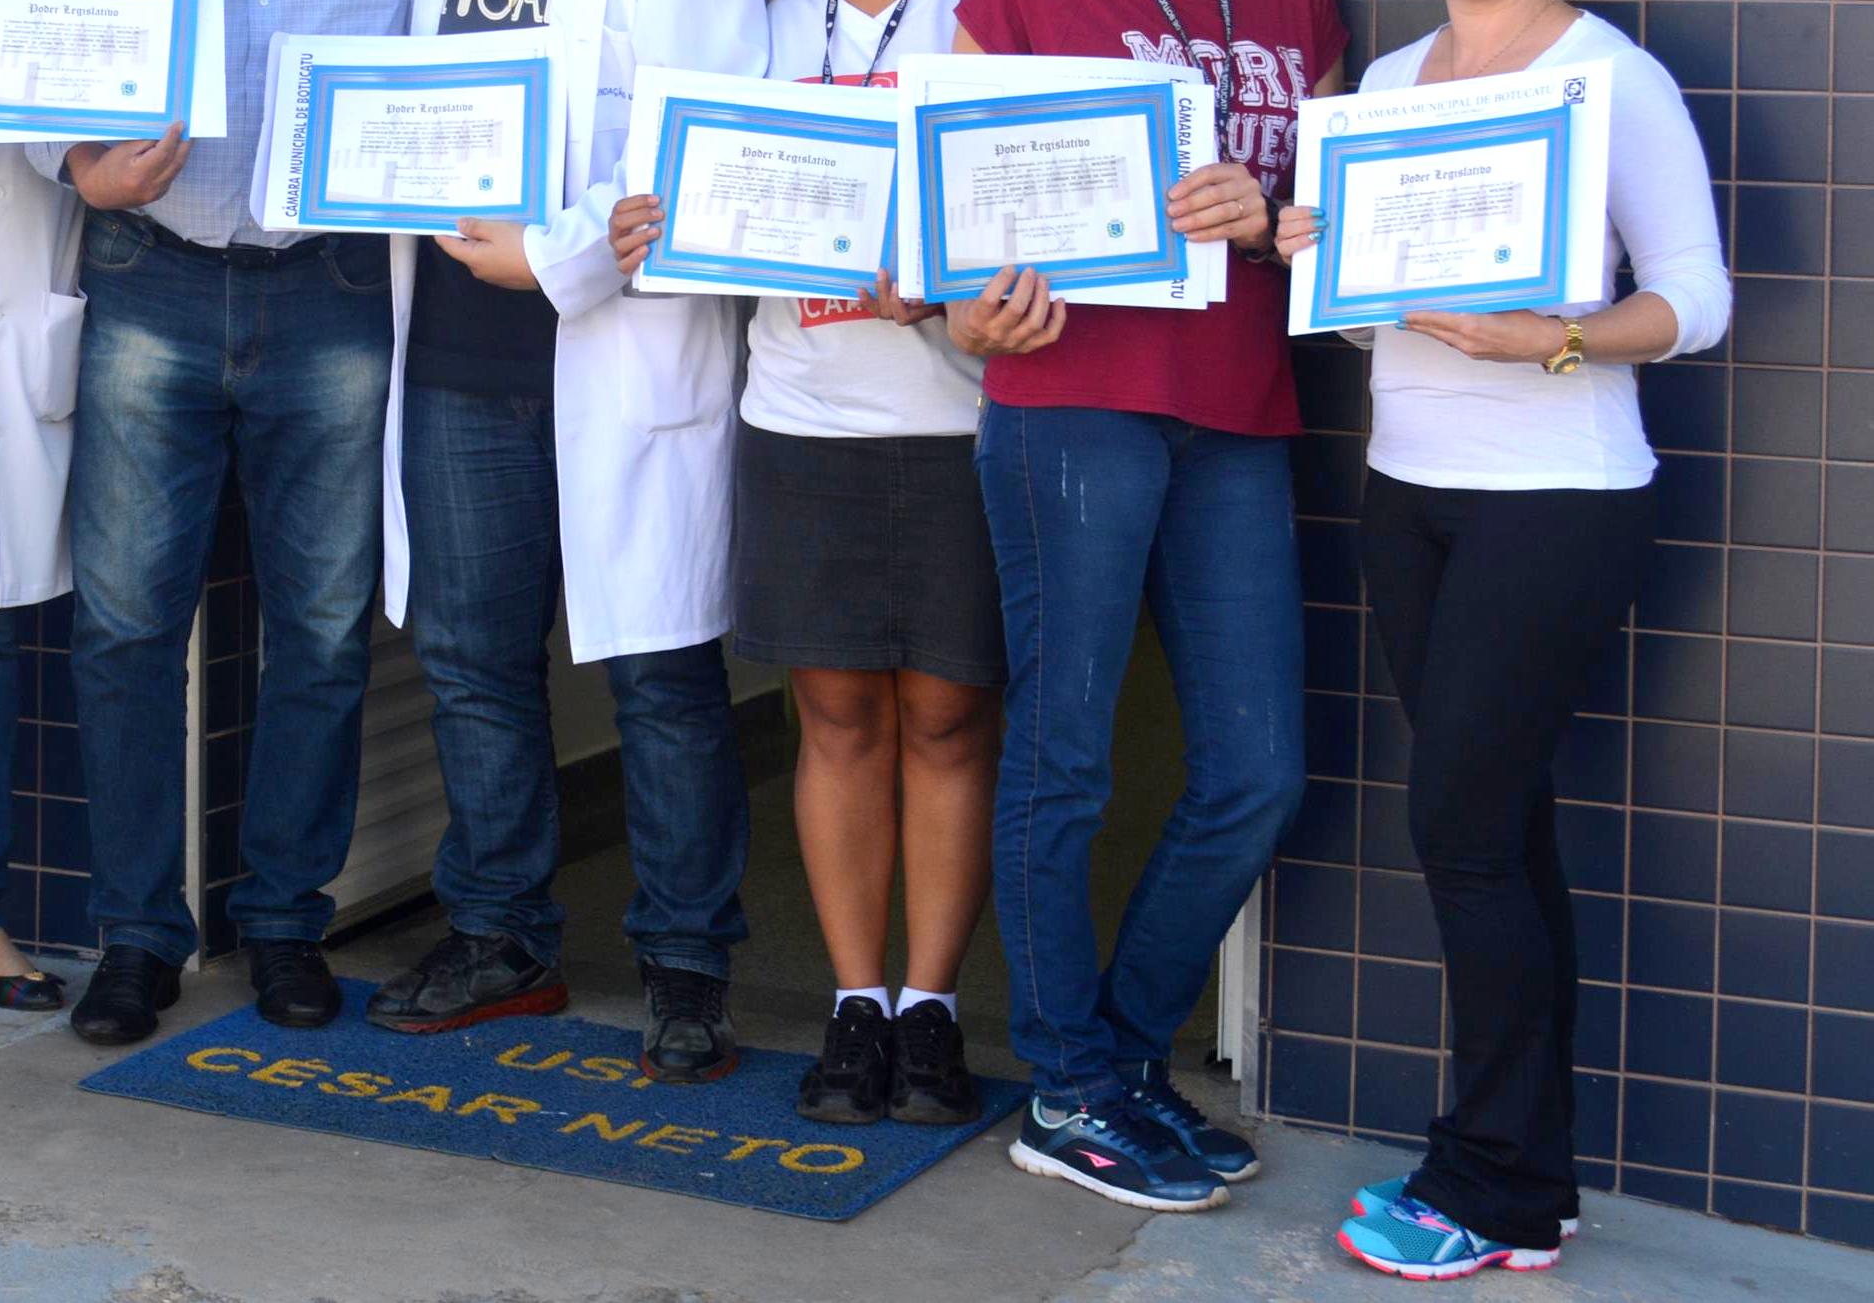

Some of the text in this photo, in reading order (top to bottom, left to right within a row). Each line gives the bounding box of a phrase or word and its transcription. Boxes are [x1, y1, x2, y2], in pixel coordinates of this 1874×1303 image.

[29, 3, 119, 17] Poder Legislativo
[386, 102, 473, 115] Poder Legislativo
[1411, 96, 1471, 114] MUNICIPAL
[1476, 95, 1490, 105] DE
[1494, 84, 1554, 102] BOTUCATU
[1178, 97, 1197, 147] CÂMARA
[283, 53, 314, 218] CÂMARA MUNICIPAL DE BOTUCATU
[995, 138, 1090, 157] Poder Legislativo
[741, 146, 837, 167] Poder Legislativo
[1399, 165, 1492, 186] Poder Legislativo
[496, 1042, 653, 1089] US
[561, 1112, 865, 1174] NETO
